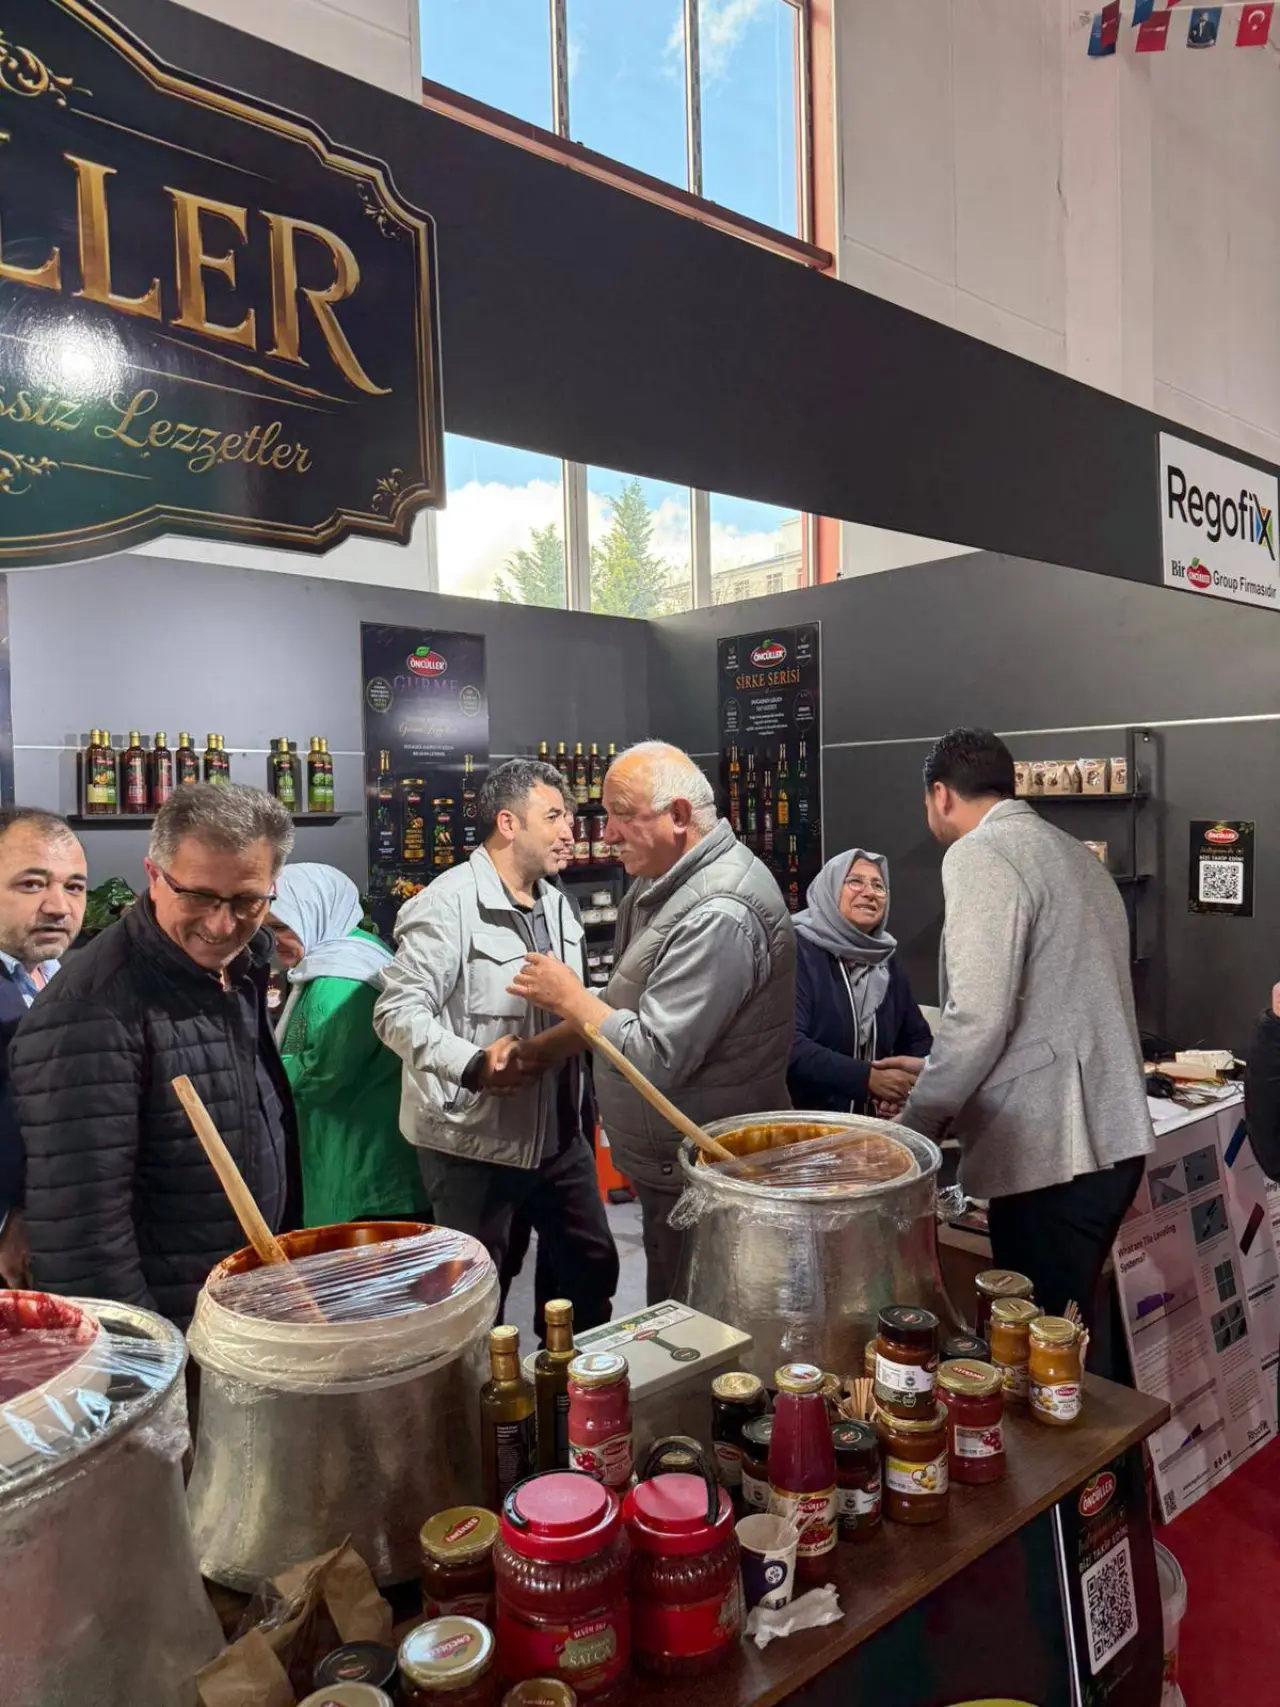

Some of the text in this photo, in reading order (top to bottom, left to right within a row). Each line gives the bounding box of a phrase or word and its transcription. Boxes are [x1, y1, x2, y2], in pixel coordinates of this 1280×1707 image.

[94, 389, 313, 474] Lezzetler
[1167, 464, 1276, 562] Regofix
[1171, 560, 1186, 578] Bir
[1213, 570, 1239, 594] Group
[736, 665, 801, 691] SİRKE SERİSİ
